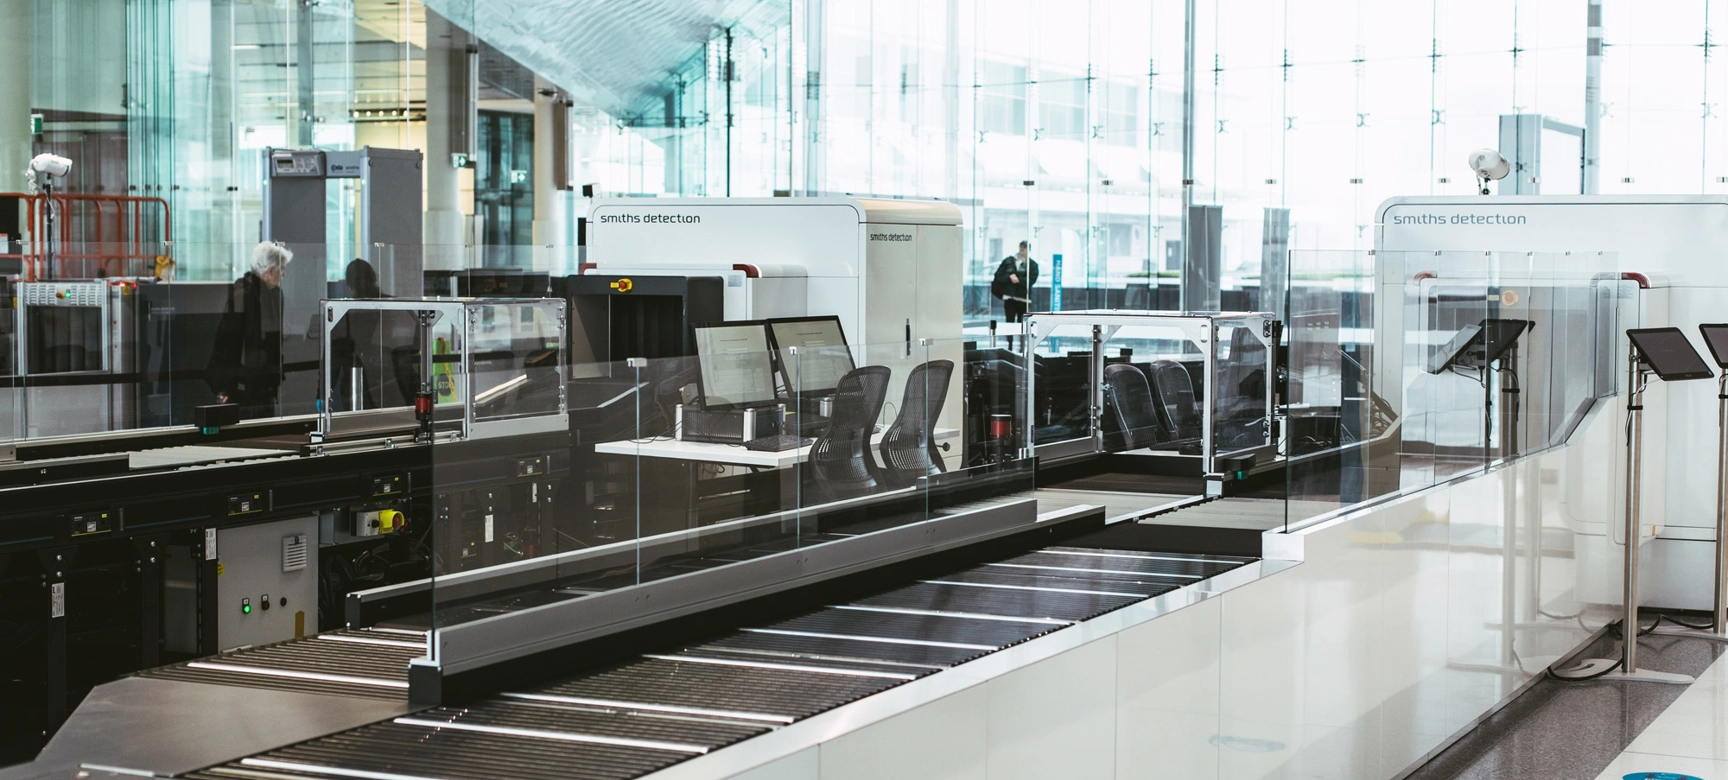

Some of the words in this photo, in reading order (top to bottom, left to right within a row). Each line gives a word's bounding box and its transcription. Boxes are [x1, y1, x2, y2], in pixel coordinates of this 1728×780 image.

[600, 214, 640, 223] smiths
[643, 214, 701, 223] detection
[1393, 213, 1447, 225] smiths
[1450, 213, 1527, 225] detection
[870, 233, 888, 241] smiths
[888, 233, 913, 242] detection
